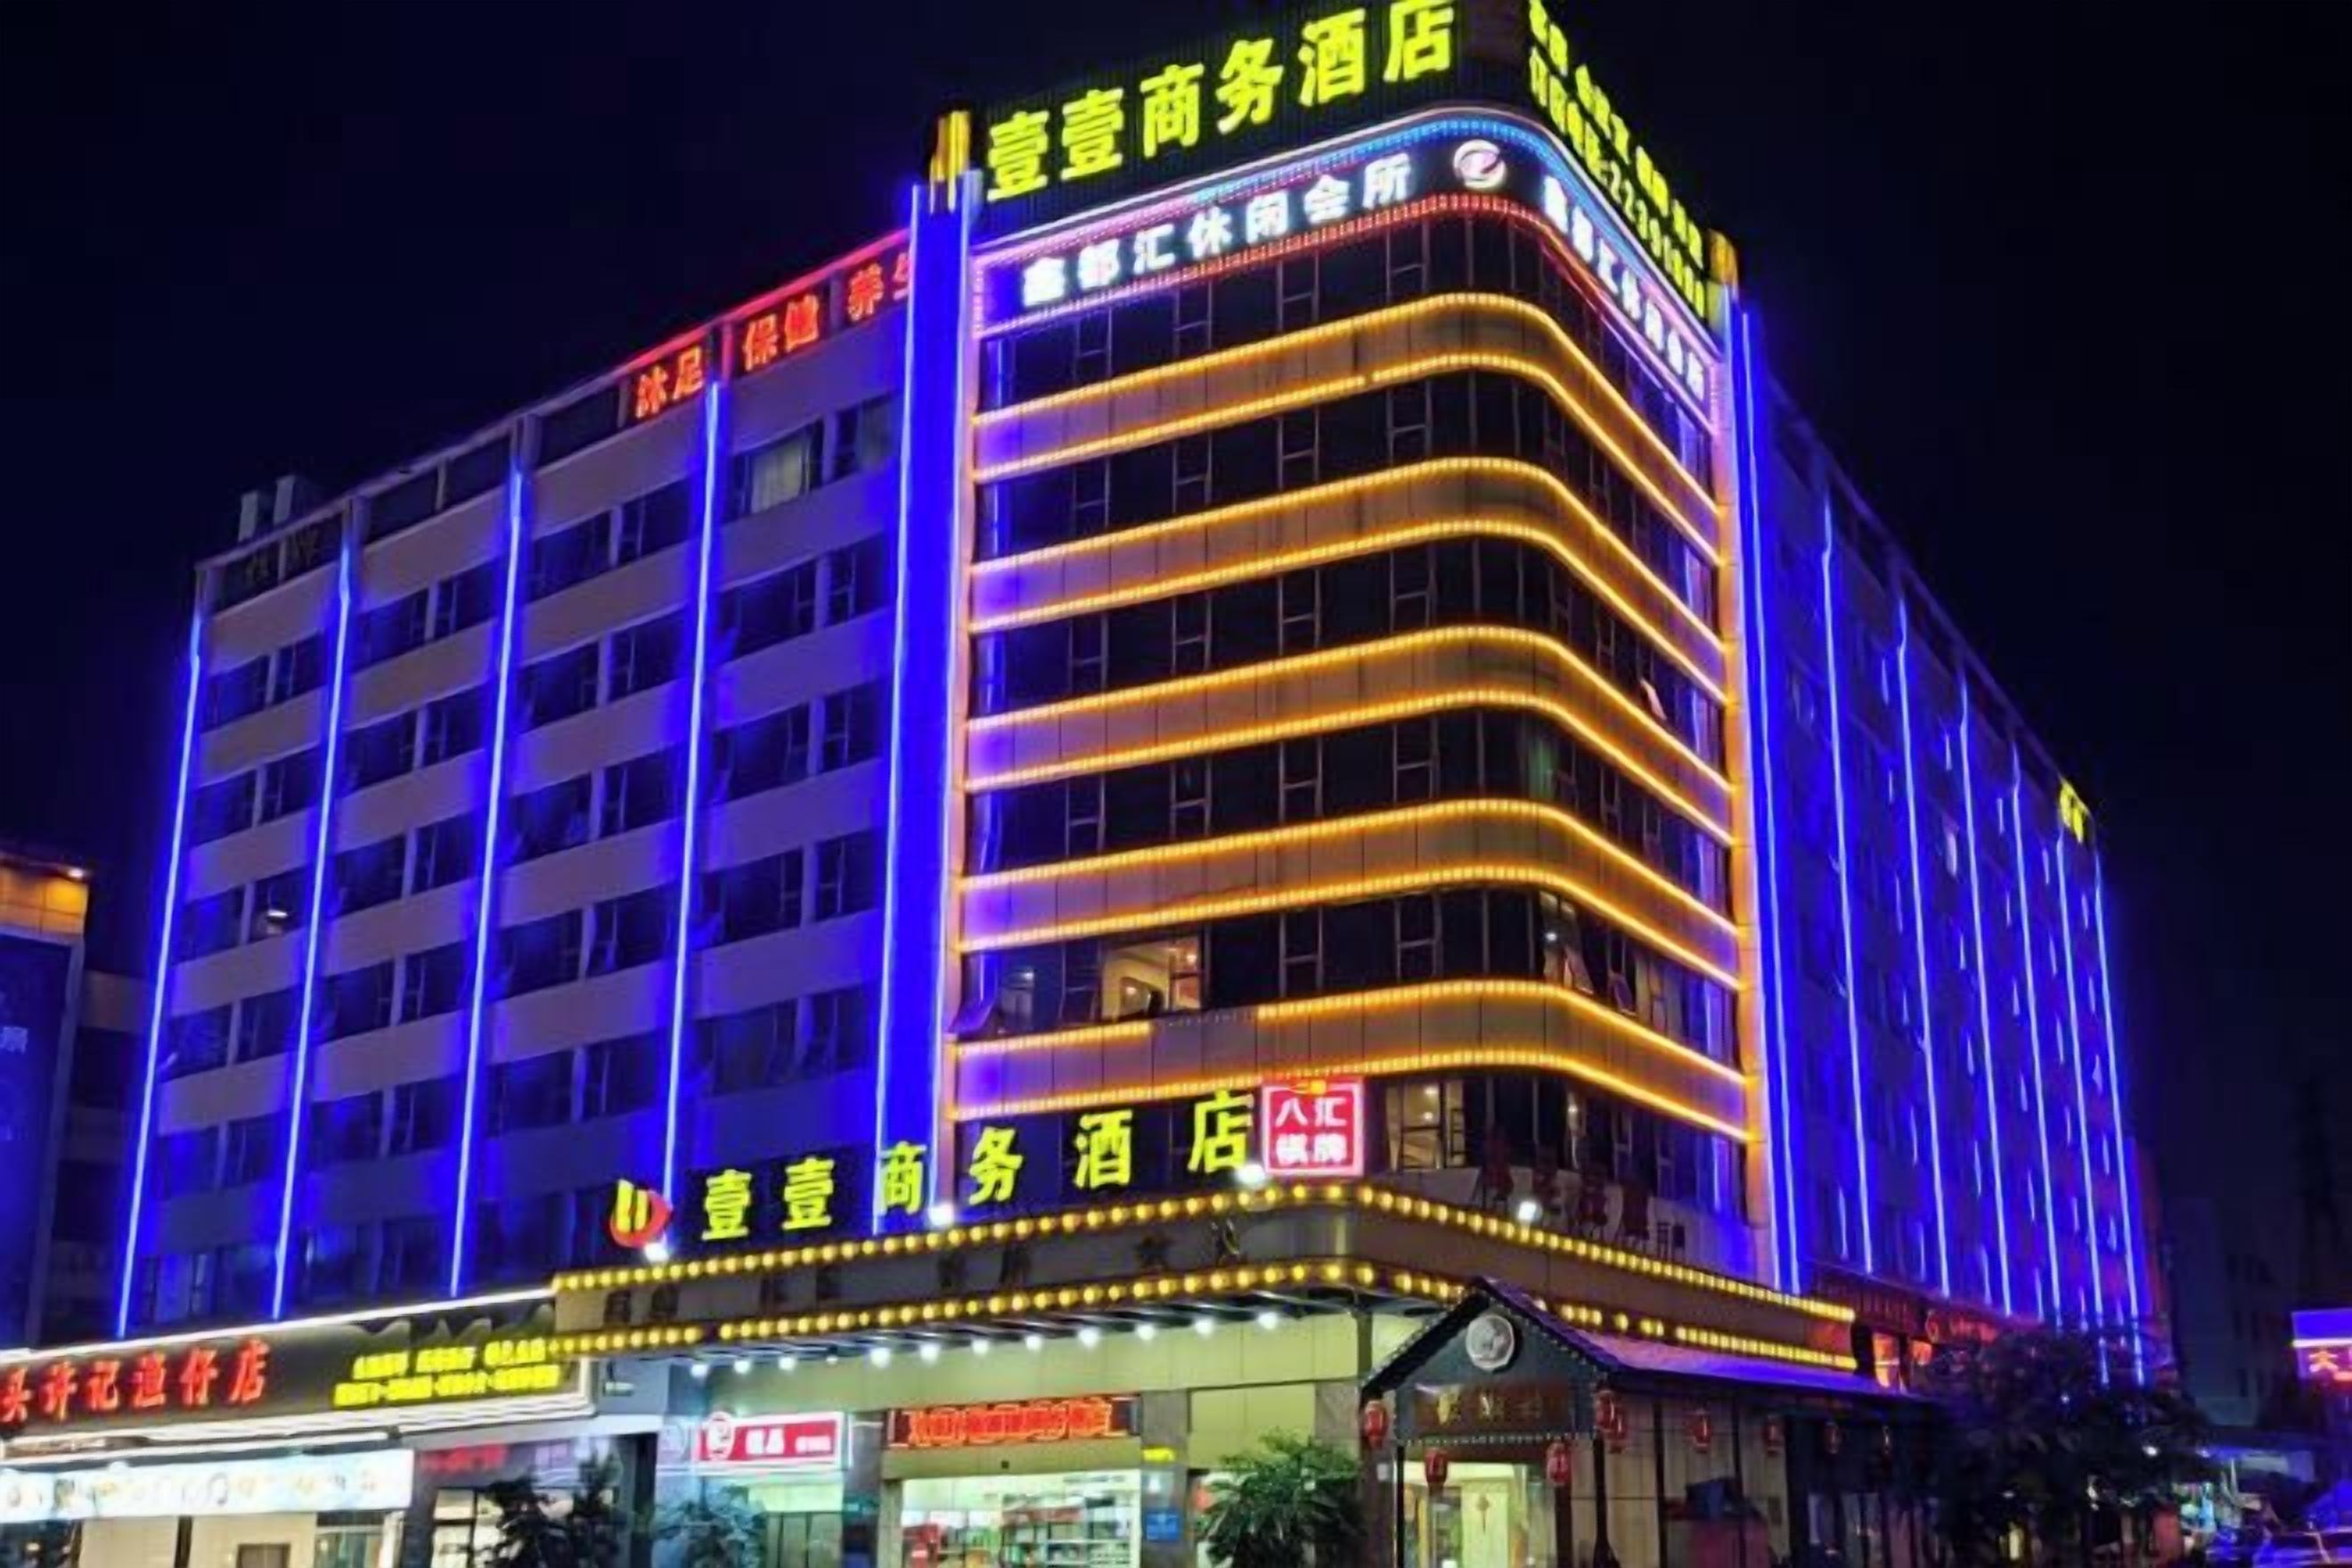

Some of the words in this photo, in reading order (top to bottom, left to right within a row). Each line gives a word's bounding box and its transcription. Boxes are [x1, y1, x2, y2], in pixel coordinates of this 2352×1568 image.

[986, 0, 1456, 201] 壹壹商务酒店
[701, 1090, 1255, 1242] 壹壹商务酒店
[1274, 1096, 1348, 1127] 八汇
